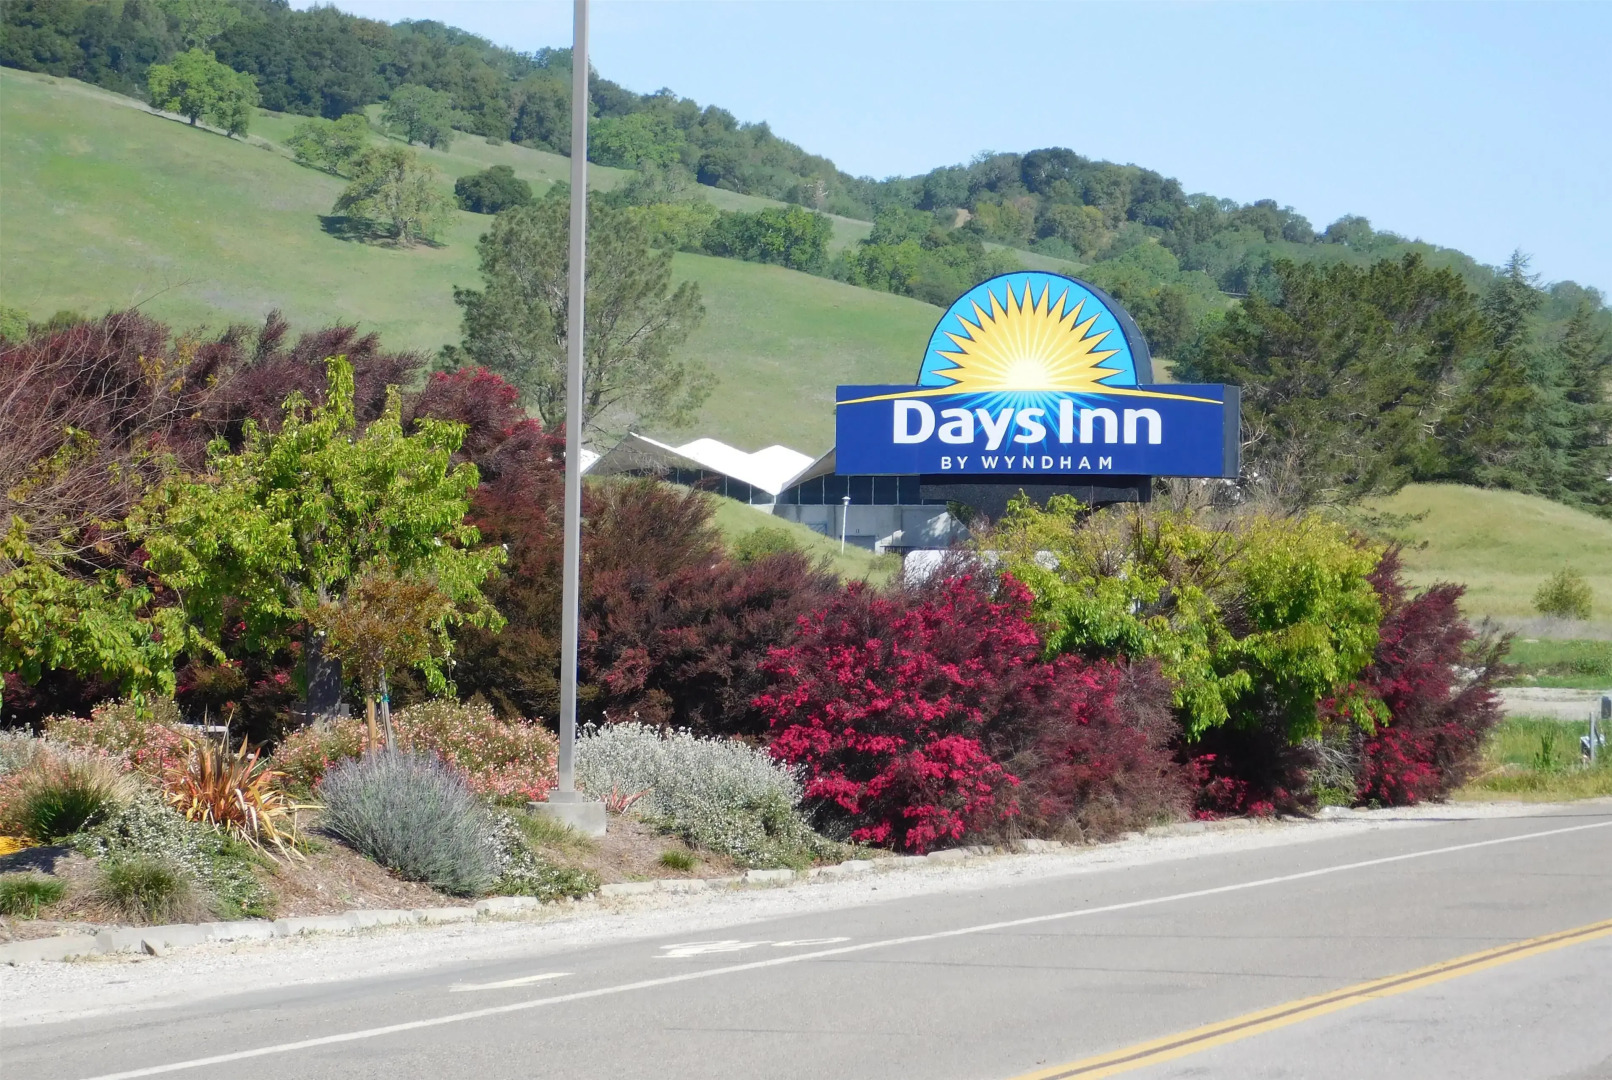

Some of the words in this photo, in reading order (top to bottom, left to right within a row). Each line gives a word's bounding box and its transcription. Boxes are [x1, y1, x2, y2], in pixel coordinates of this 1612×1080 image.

[893, 399, 1047, 451] Days
[1059, 399, 1162, 445] Inn
[941, 456, 968, 470] BY
[981, 456, 1113, 470] WYNDHAM
